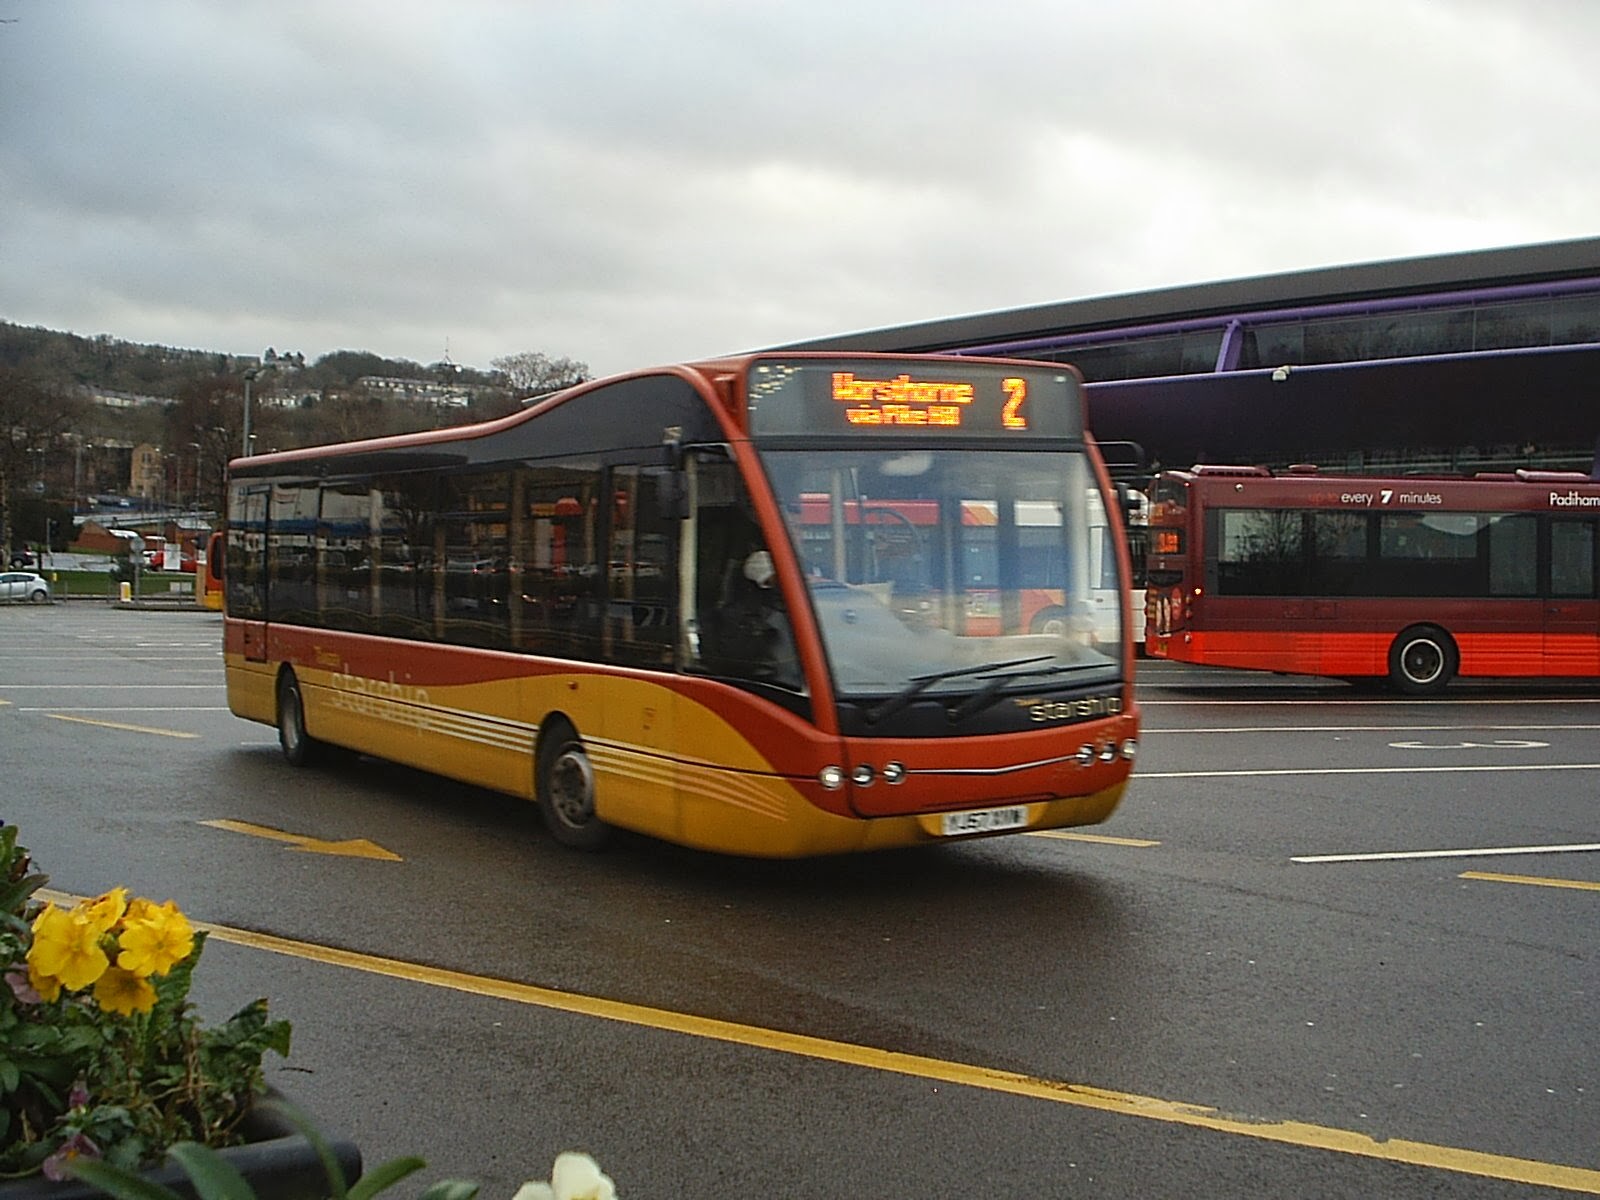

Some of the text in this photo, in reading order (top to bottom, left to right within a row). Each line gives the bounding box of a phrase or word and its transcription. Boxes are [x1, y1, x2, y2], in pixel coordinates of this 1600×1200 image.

[1001, 377, 1027, 431] 2
[1341, 492, 1373, 506] every
[1380, 490, 1393, 504] 7
[1399, 491, 1442, 504] minutes
[1550, 491, 1600, 506] Padiham
